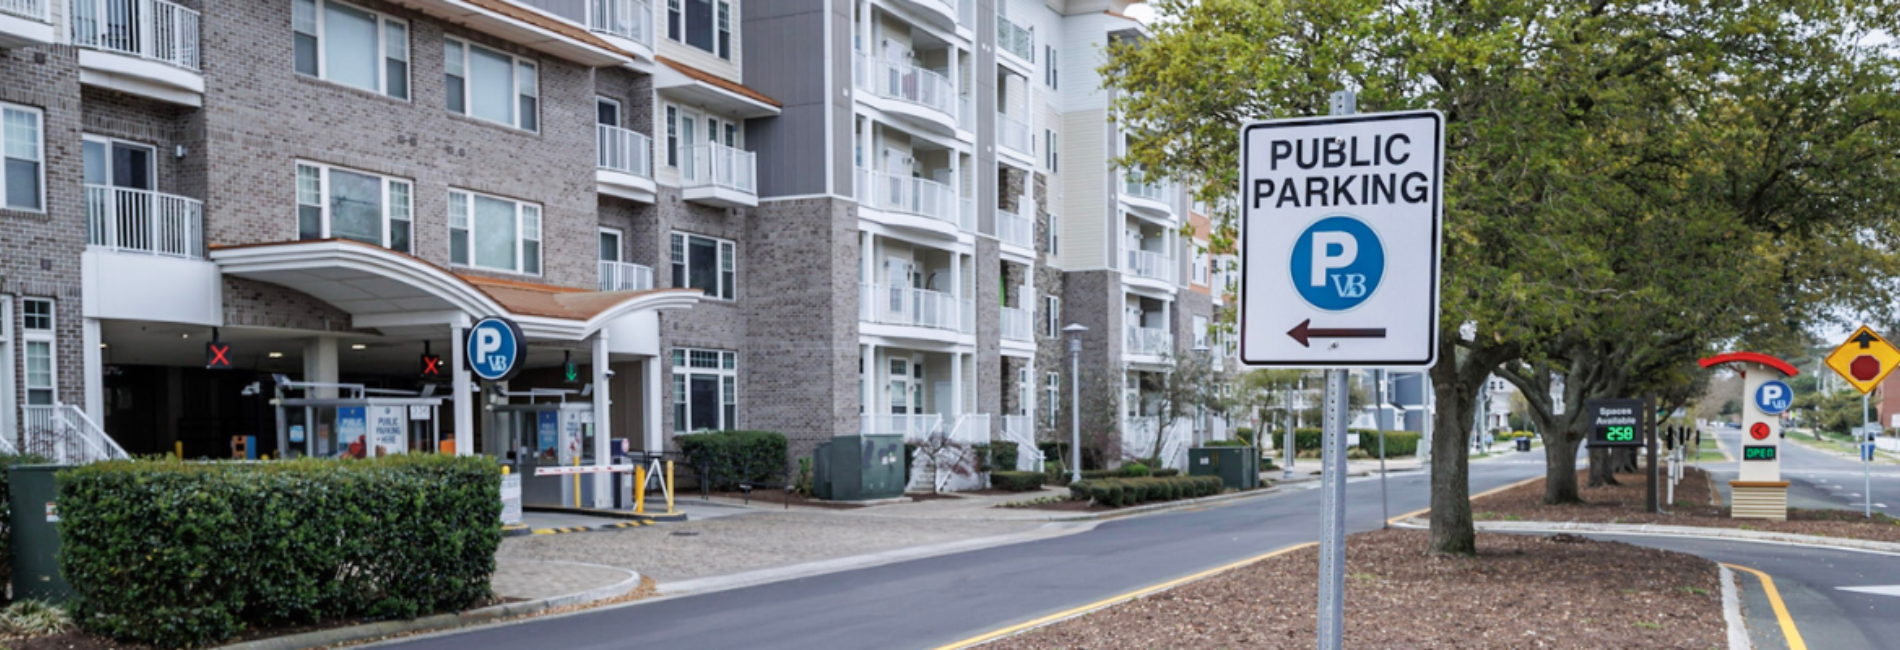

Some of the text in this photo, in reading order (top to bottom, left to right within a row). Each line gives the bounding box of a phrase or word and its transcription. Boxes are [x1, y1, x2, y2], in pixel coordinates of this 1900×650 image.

[1271, 133, 1411, 170] PUBLIC
[1253, 172, 1428, 209] PARKING
[1311, 230, 1359, 287] P
[477, 327, 502, 364] P
[1763, 385, 1782, 405] P
[1599, 407, 1632, 417] Spaces
[378, 418, 398, 426] PUBLIC
[1595, 416, 1637, 425] Available
[381, 436, 396, 444] HERE
[1606, 426, 1633, 441] 258
[1746, 448, 1774, 458] OPEN
